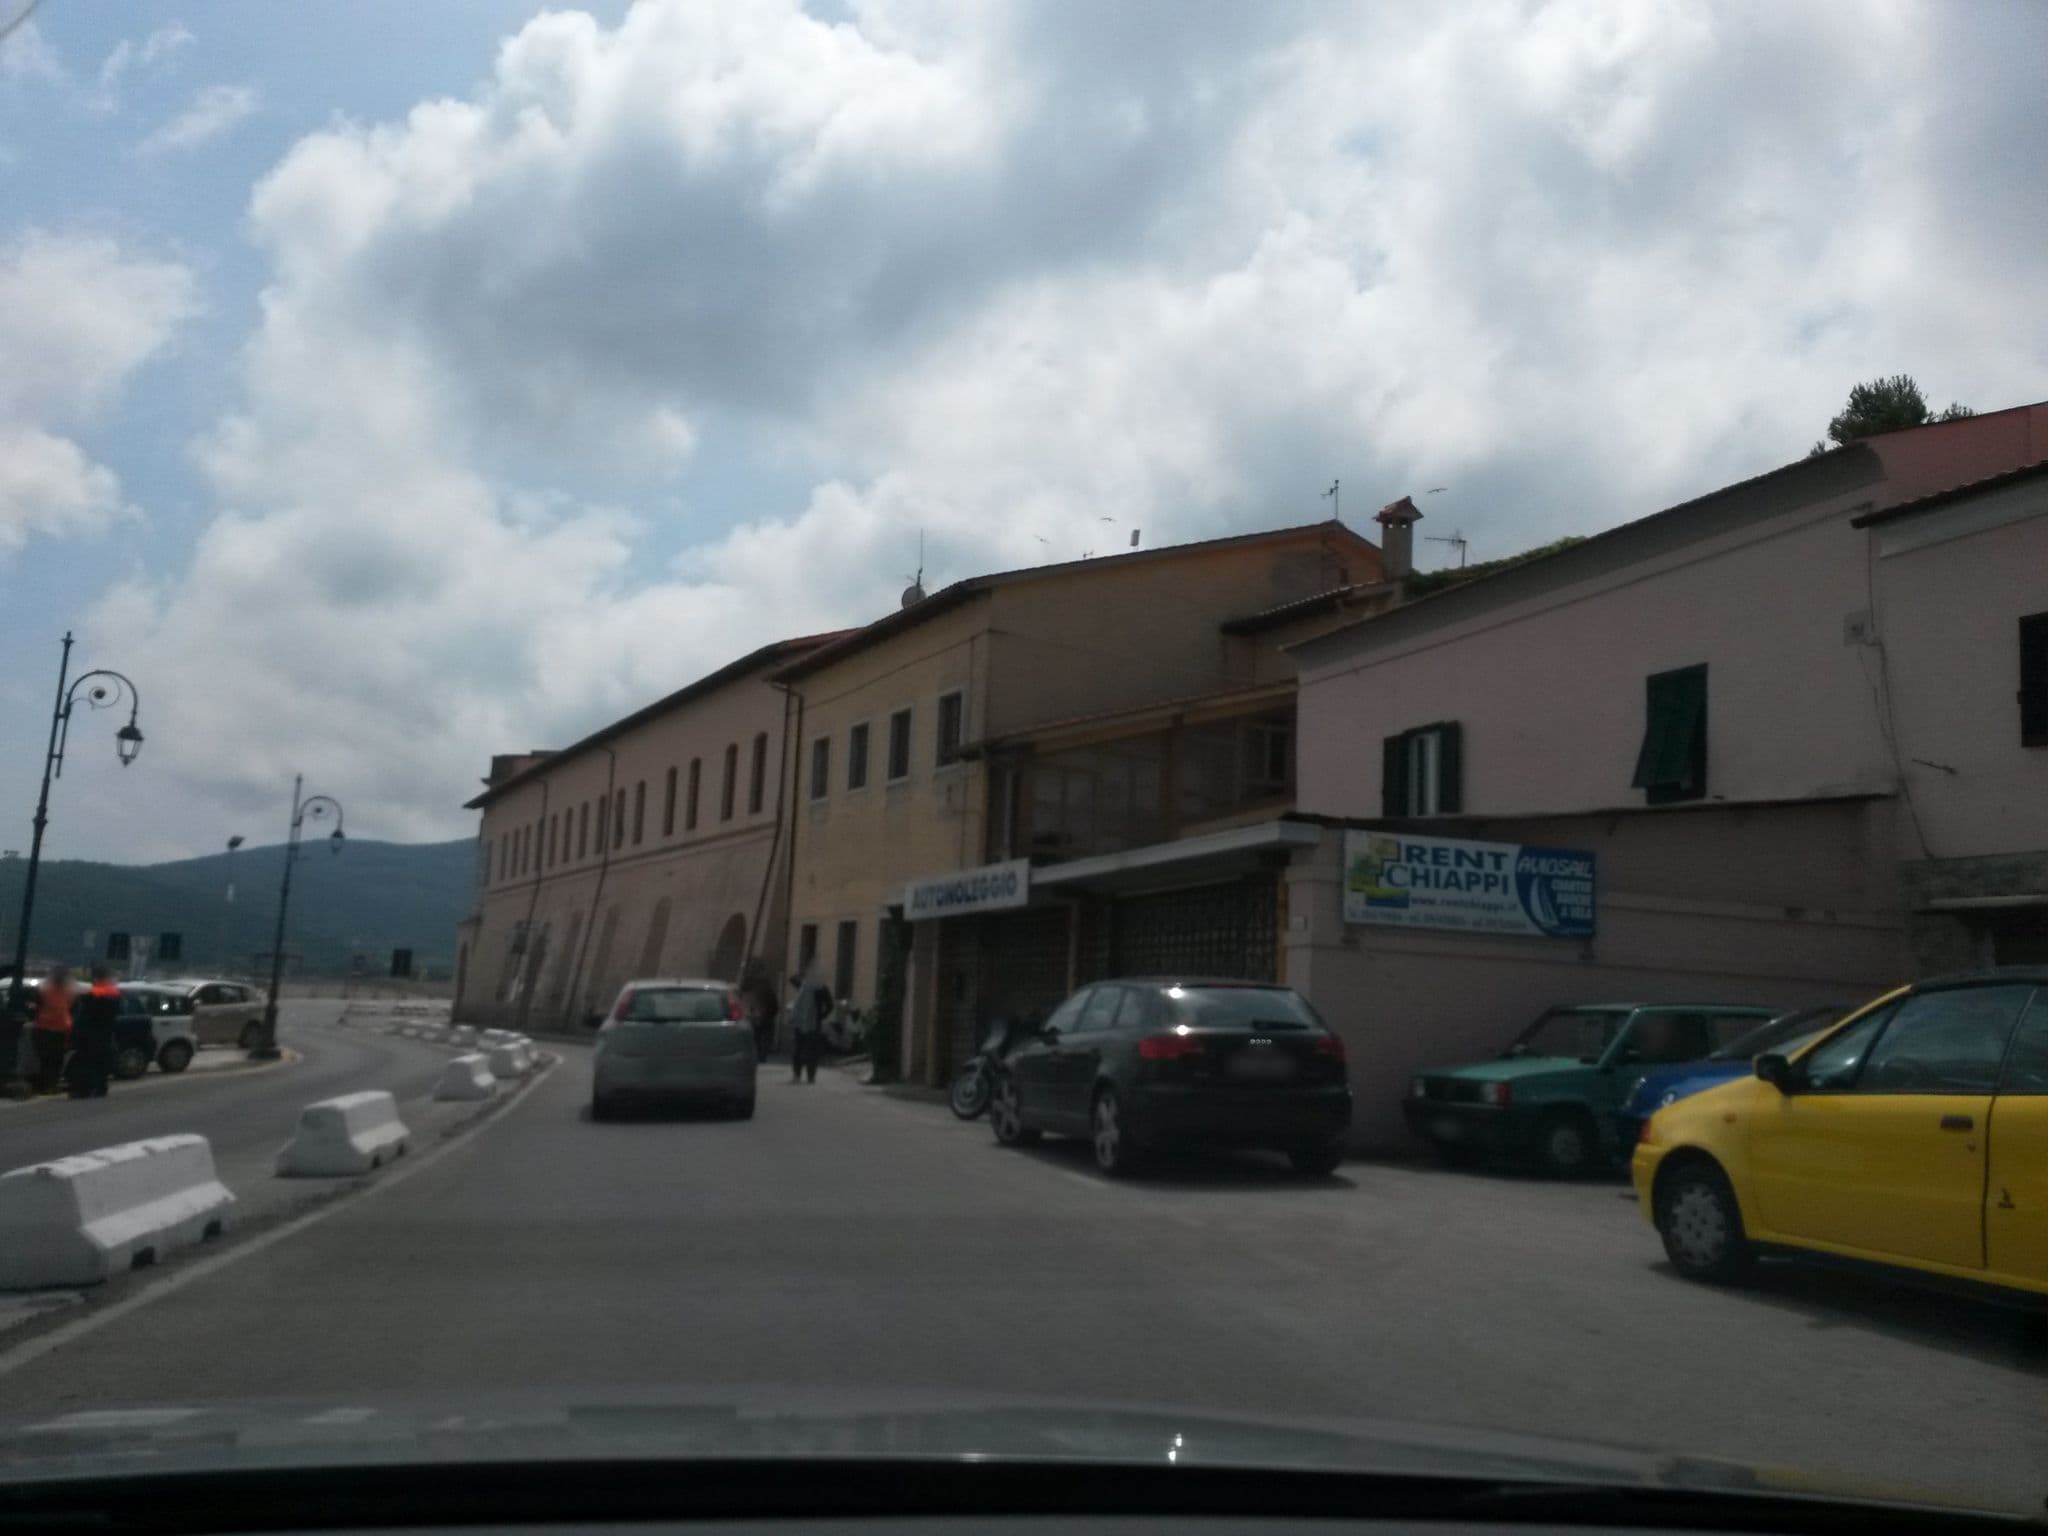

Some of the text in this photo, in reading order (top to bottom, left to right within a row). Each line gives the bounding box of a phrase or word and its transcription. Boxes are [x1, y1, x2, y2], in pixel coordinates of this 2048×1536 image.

[1405, 844, 1509, 871] RENT
[912, 871, 1017, 910] AUTONOLEGGIO
[1385, 864, 1509, 896] CHIAPPI
